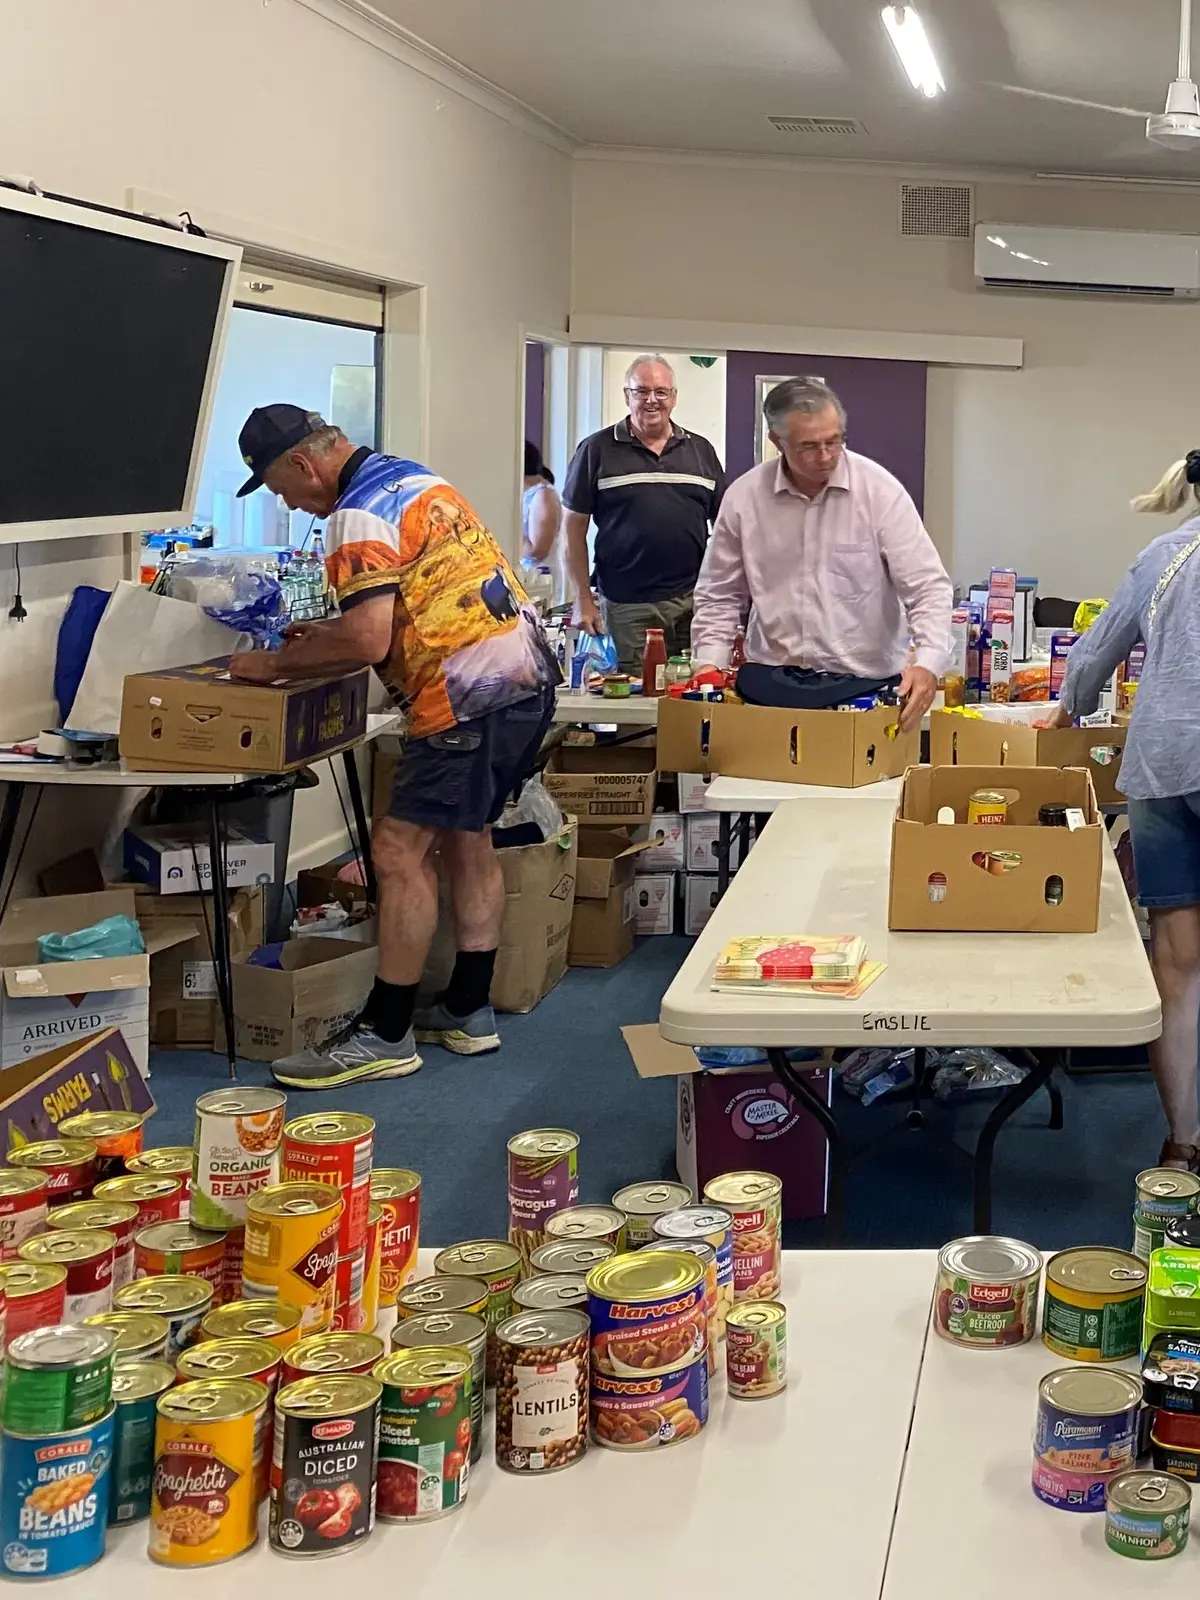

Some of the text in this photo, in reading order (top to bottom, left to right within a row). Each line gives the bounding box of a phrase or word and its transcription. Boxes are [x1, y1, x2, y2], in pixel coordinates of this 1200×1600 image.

[1000, 652, 1008, 670] CORN
[594, 776, 648, 785] 1000005747
[596, 791, 631, 799] STRAIGHT
[981, 815, 1004, 824] HEINZ
[23, 1014, 101, 1040] ARRIVED
[747, 1103, 777, 1118] MASTER
[209, 1158, 271, 1172] ORGANIC
[211, 1179, 268, 1196] BEANS
[973, 1286, 1009, 1301] Edgell
[609, 1291, 697, 1320] Harvest
[969, 1318, 1007, 1329] BEETROOT
[607, 1330, 640, 1341] Braised
[641, 1324, 670, 1336] Steak
[515, 1394, 576, 1416] LENTILS
[313, 1421, 354, 1438] REMANO
[39, 1443, 88, 1461] CORALE
[167, 1441, 208, 1453] CORALE
[298, 1440, 365, 1459] AUSTRALIAN
[1060, 1459, 1099, 1469] SALMON
[1068, 1451, 1092, 1461] PINK
[38, 1460, 87, 1483] BAKED
[304, 1455, 358, 1477] DICED
[155, 1464, 227, 1500] Spaghetti
[19, 1493, 97, 1532] BEANS
